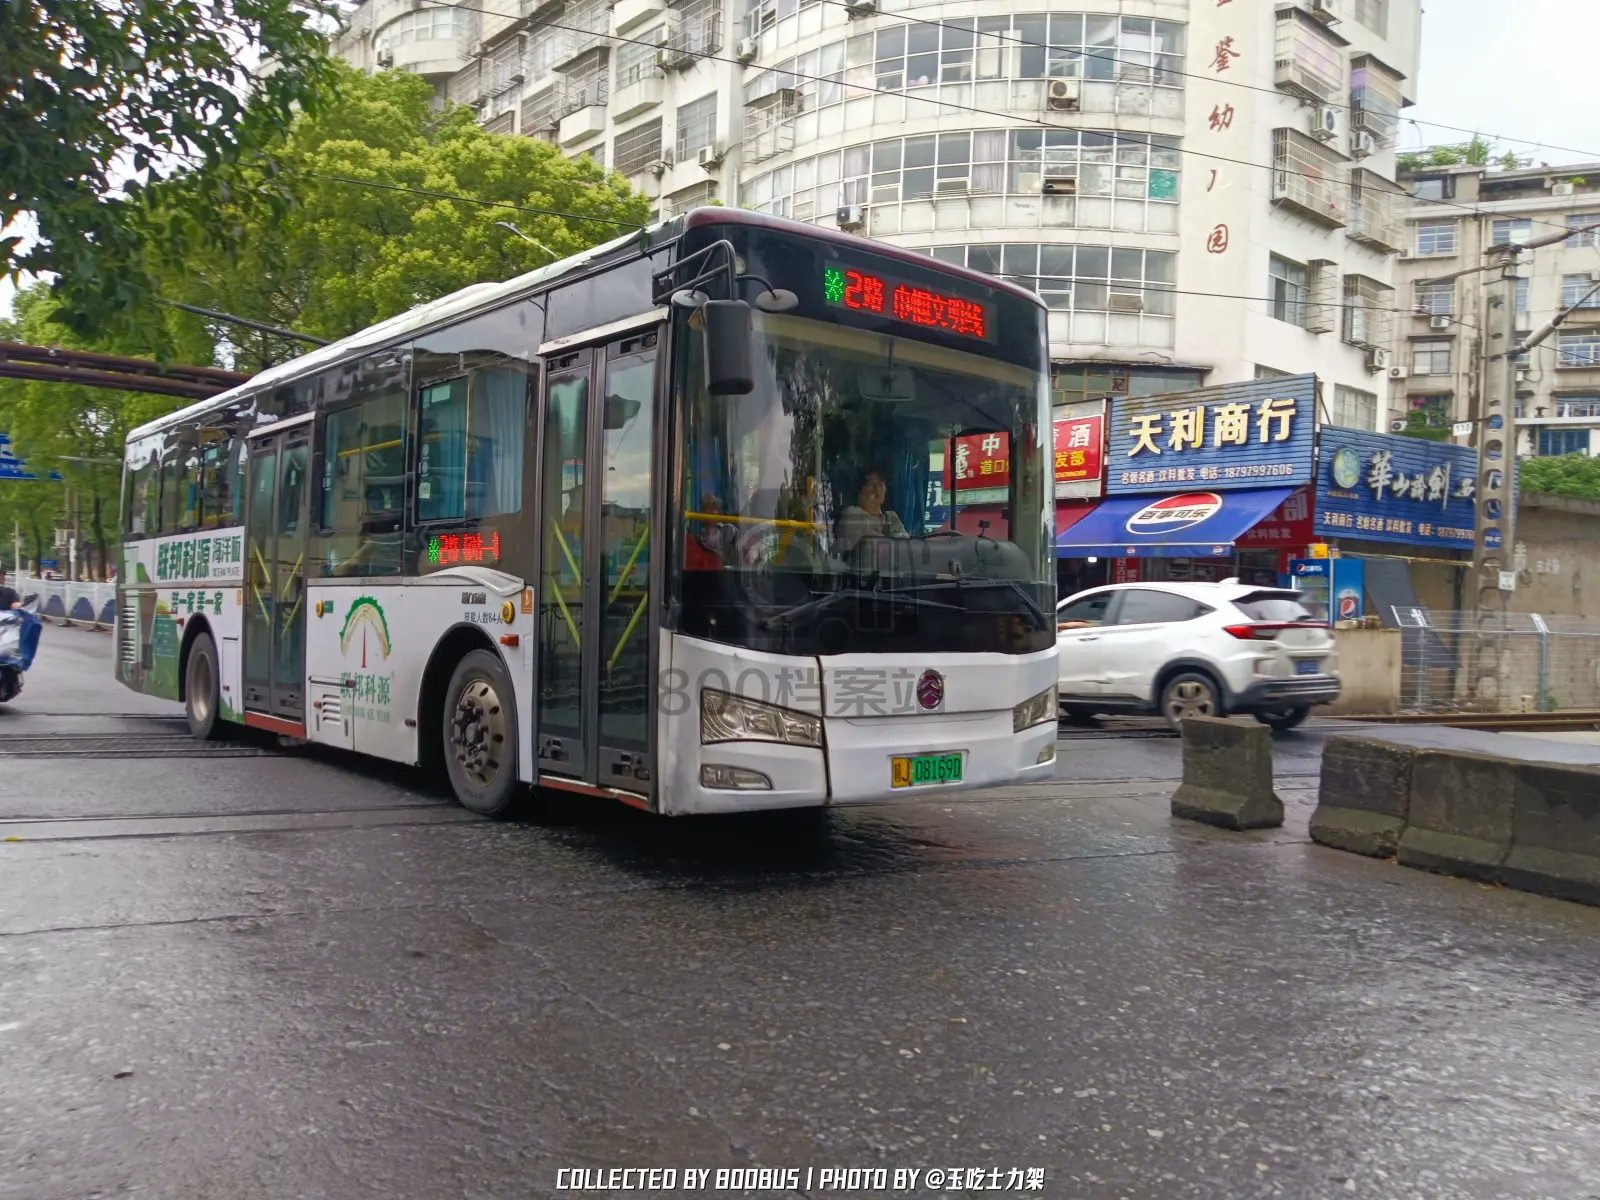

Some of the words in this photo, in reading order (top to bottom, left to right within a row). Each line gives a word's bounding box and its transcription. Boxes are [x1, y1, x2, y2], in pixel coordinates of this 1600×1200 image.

[844, 270, 884, 312] 2路
[1127, 398, 1297, 457] 天利商行
[981, 433, 1001, 456] 中
[980, 459, 1009, 475] 道口
[1225, 463, 1293, 479] 18797997606
[1137, 508, 1208, 521] 百事可乐
